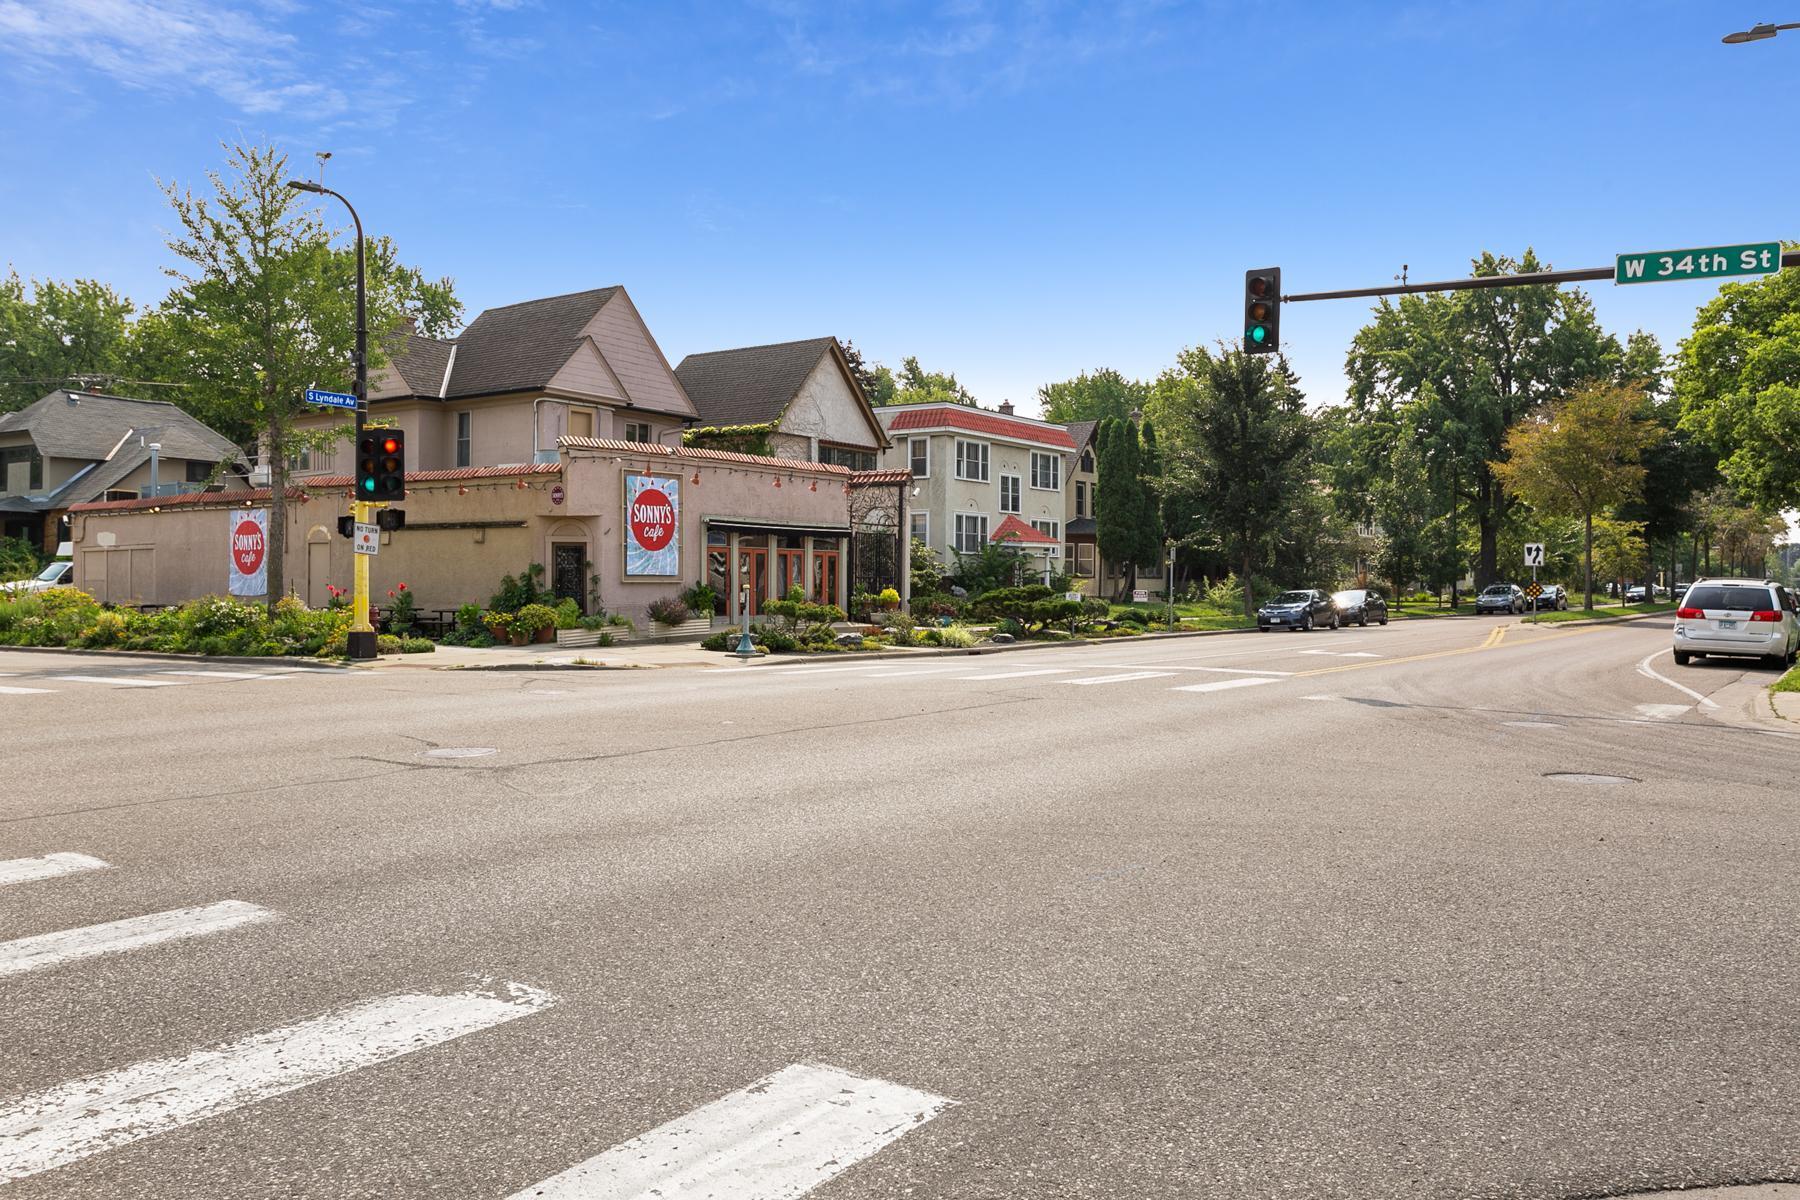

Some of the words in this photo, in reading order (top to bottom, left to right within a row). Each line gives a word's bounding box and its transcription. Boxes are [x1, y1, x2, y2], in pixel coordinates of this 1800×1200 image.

[1625, 258, 1646, 278] W
[1657, 253, 1728, 276] 34th
[1740, 249, 1772, 270] St
[308, 391, 314, 401] S
[315, 393, 344, 404] Lyndale
[345, 396, 355, 406] Av
[633, 503, 672, 524] SONNY'S
[364, 526, 378, 534] TURN
[234, 532, 262, 551] SONNY'S
[356, 543, 364, 551] ON
